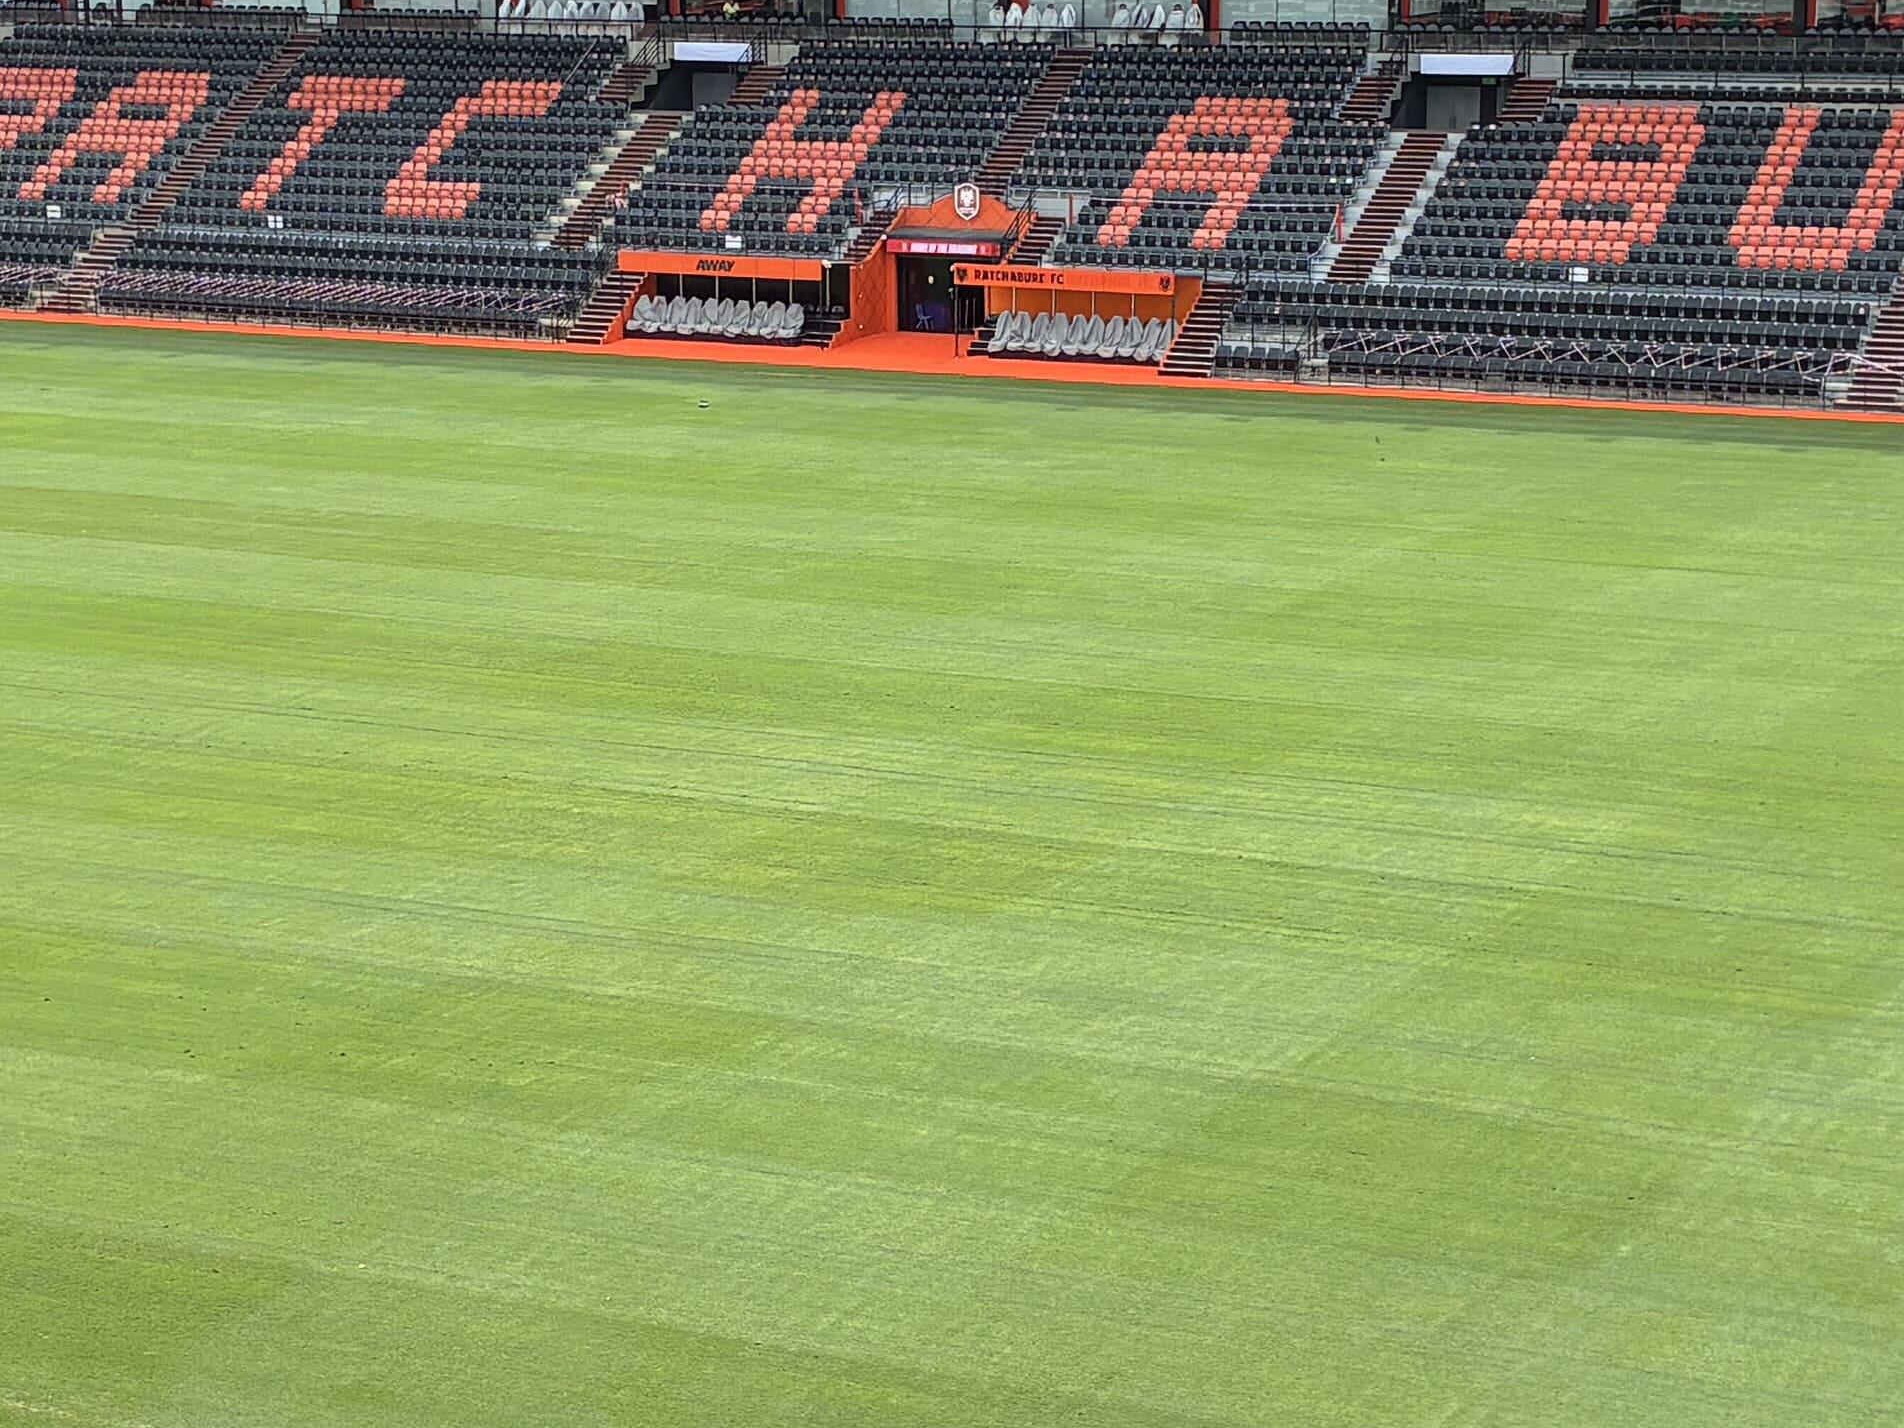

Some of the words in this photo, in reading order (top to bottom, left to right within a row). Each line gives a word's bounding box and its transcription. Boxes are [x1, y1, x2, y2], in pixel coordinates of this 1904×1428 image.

[696, 259, 736, 272] AWAY
[973, 269, 1045, 284] RATCHABURI
[1050, 273, 1065, 285] FC
